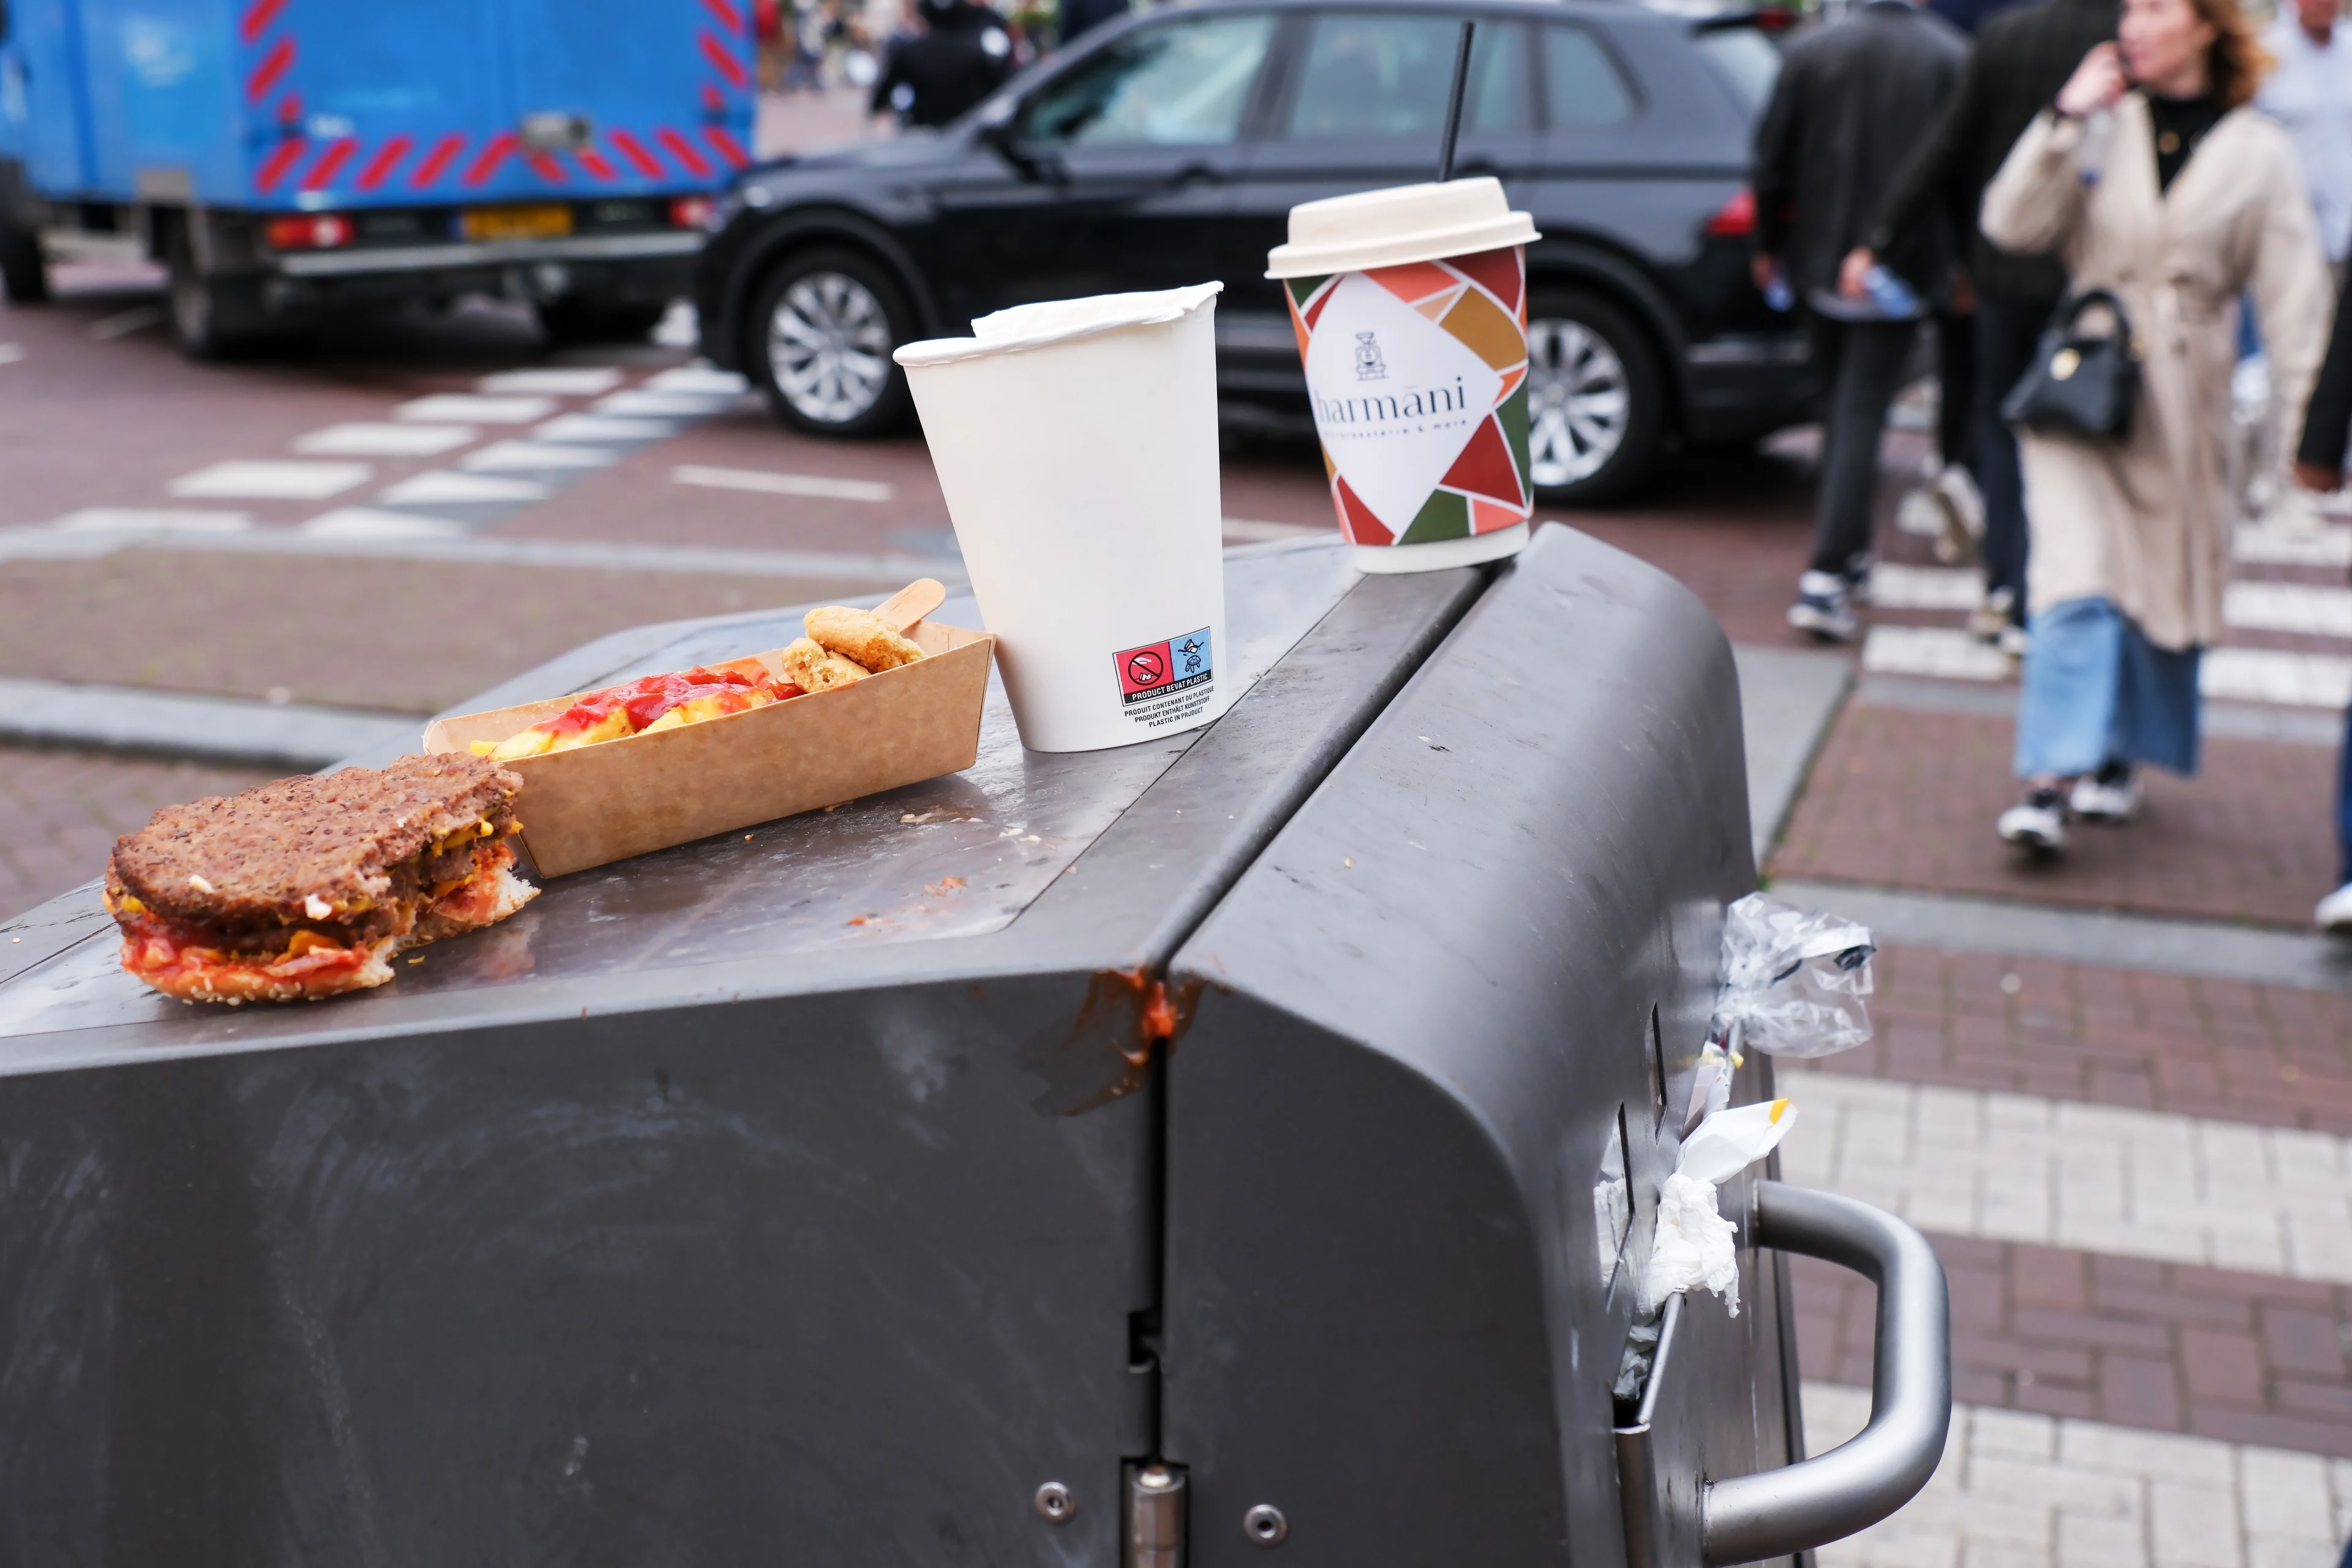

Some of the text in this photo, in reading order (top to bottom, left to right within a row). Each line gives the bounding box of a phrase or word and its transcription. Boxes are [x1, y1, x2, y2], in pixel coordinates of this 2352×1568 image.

[1132, 673, 1208, 701] PRODUCT BEVAT PLASTIC
[1125, 706, 1151, 717] PRODUIT
[1152, 696, 1185, 710] CONTENANT
[1193, 685, 1214, 699] PLASTIQUE
[1135, 696, 1210, 723] PRODUKT ENTHÄLT KUNSTSTOFF
[1149, 716, 1174, 728] PLASTIC
[1181, 706, 1203, 719] PRODUCT
